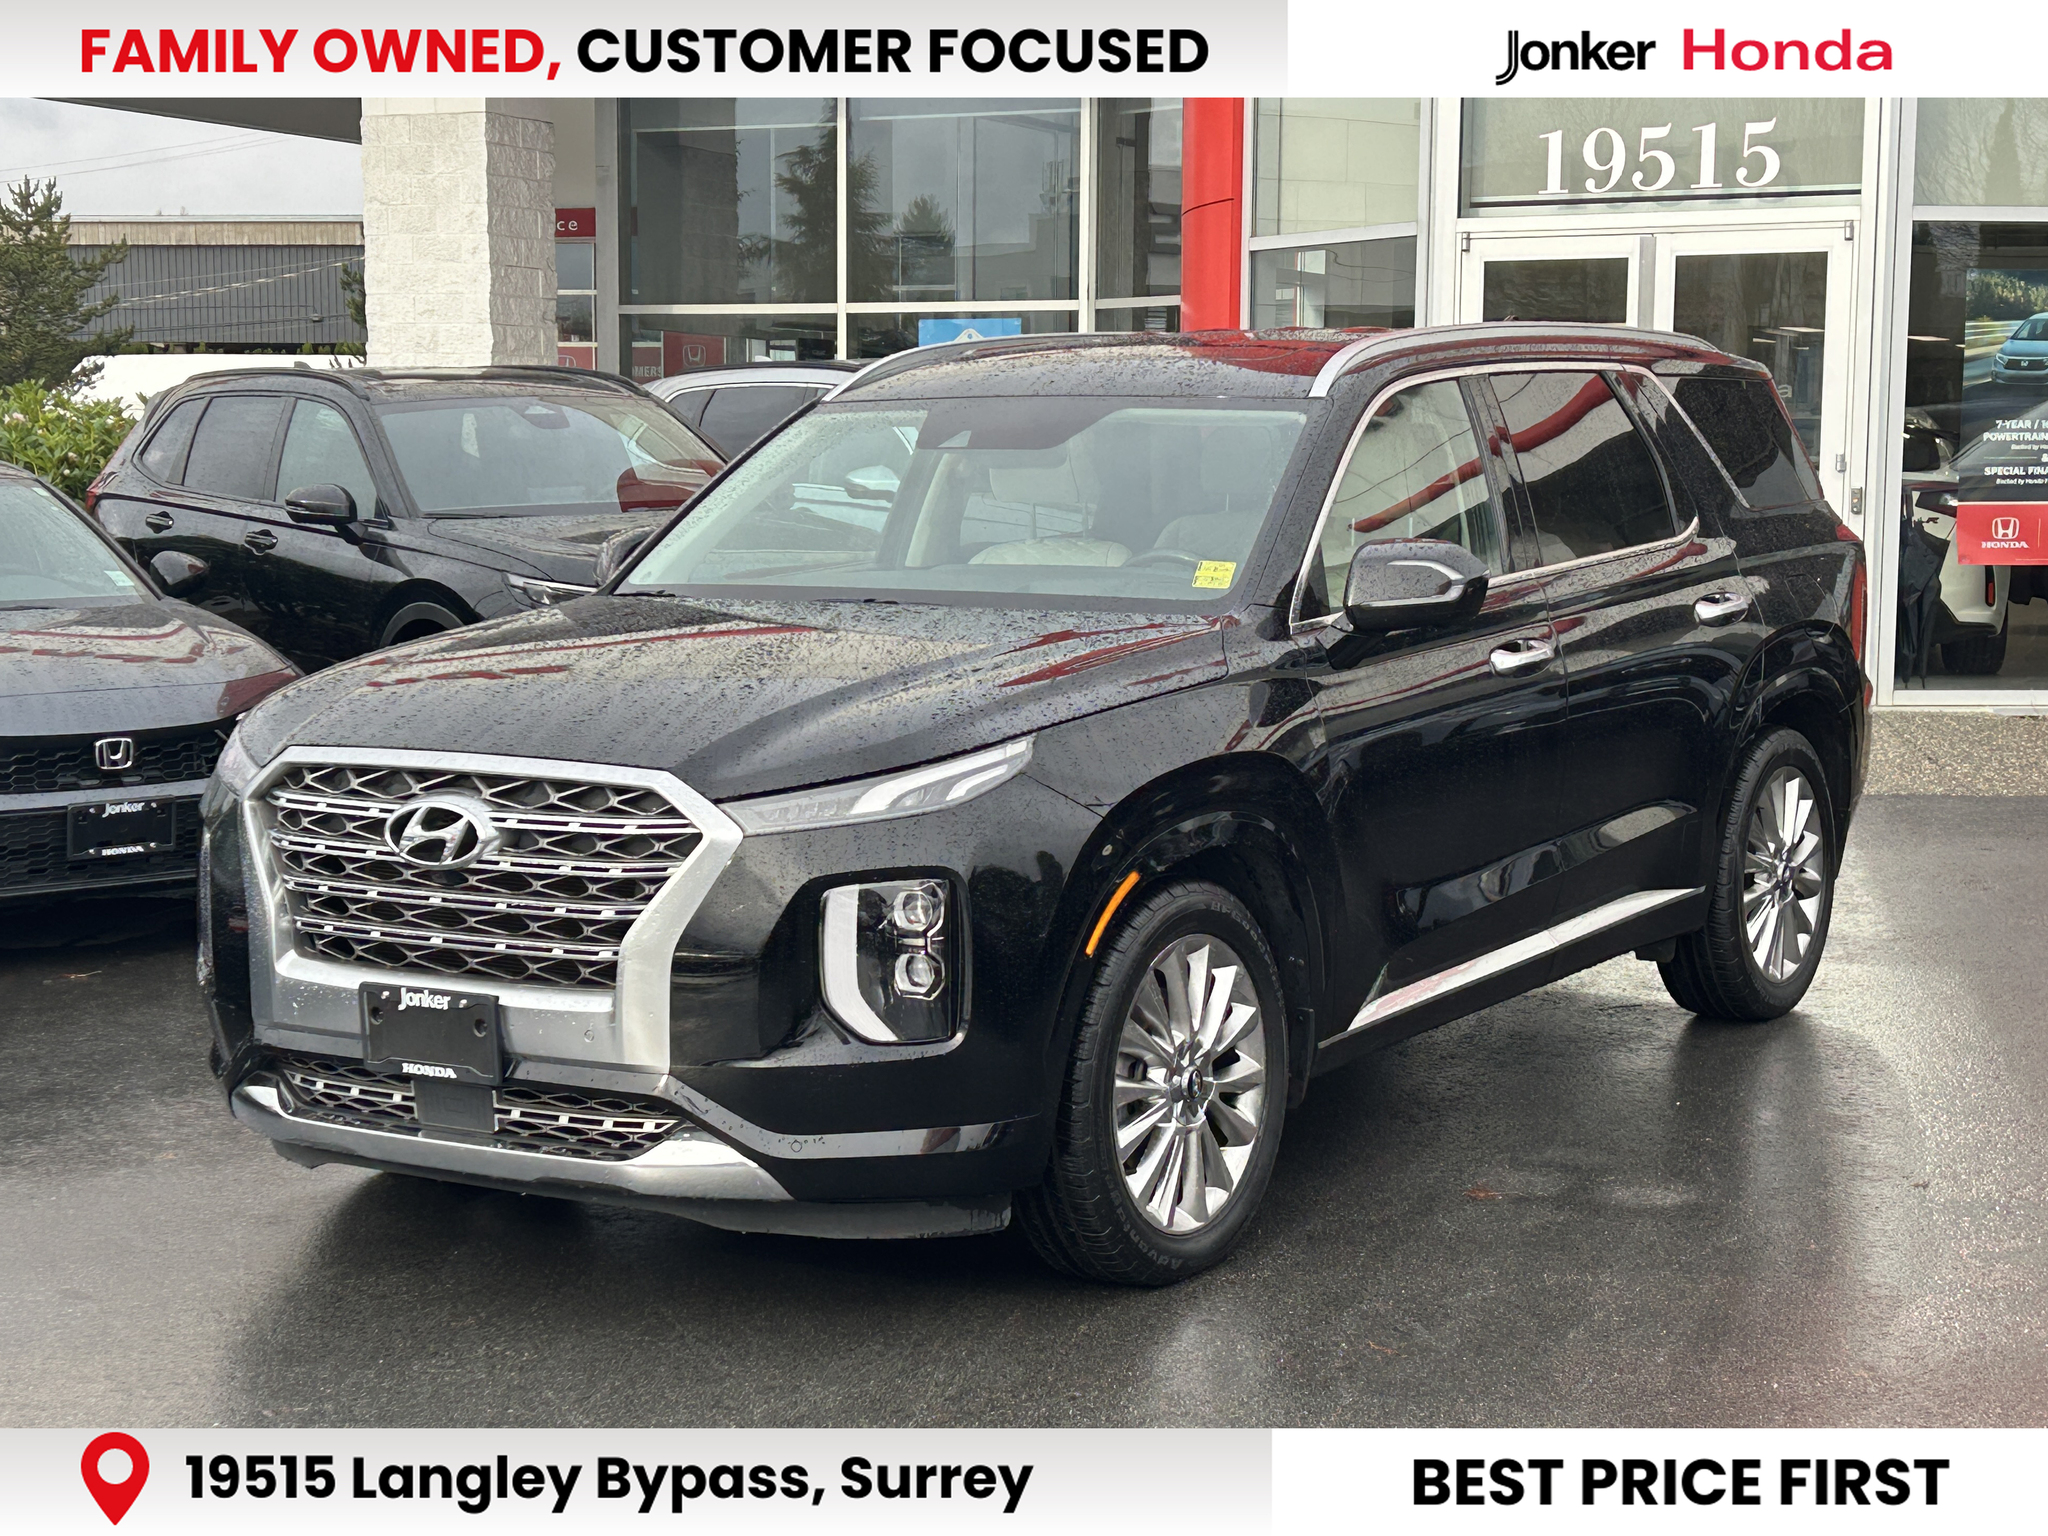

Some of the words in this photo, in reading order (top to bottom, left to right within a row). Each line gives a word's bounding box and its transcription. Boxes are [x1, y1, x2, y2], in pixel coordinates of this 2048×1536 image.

[1538, 117, 1781, 195] 19515
[557, 220, 579, 231] ce
[1984, 466, 2026, 476] SPECIAL
[1981, 541, 2030, 549] HONDA
[101, 801, 145, 818] Jonker
[101, 845, 145, 856] HONDA
[398, 987, 452, 1011] Jonker
[401, 1062, 458, 1079] HONDA
